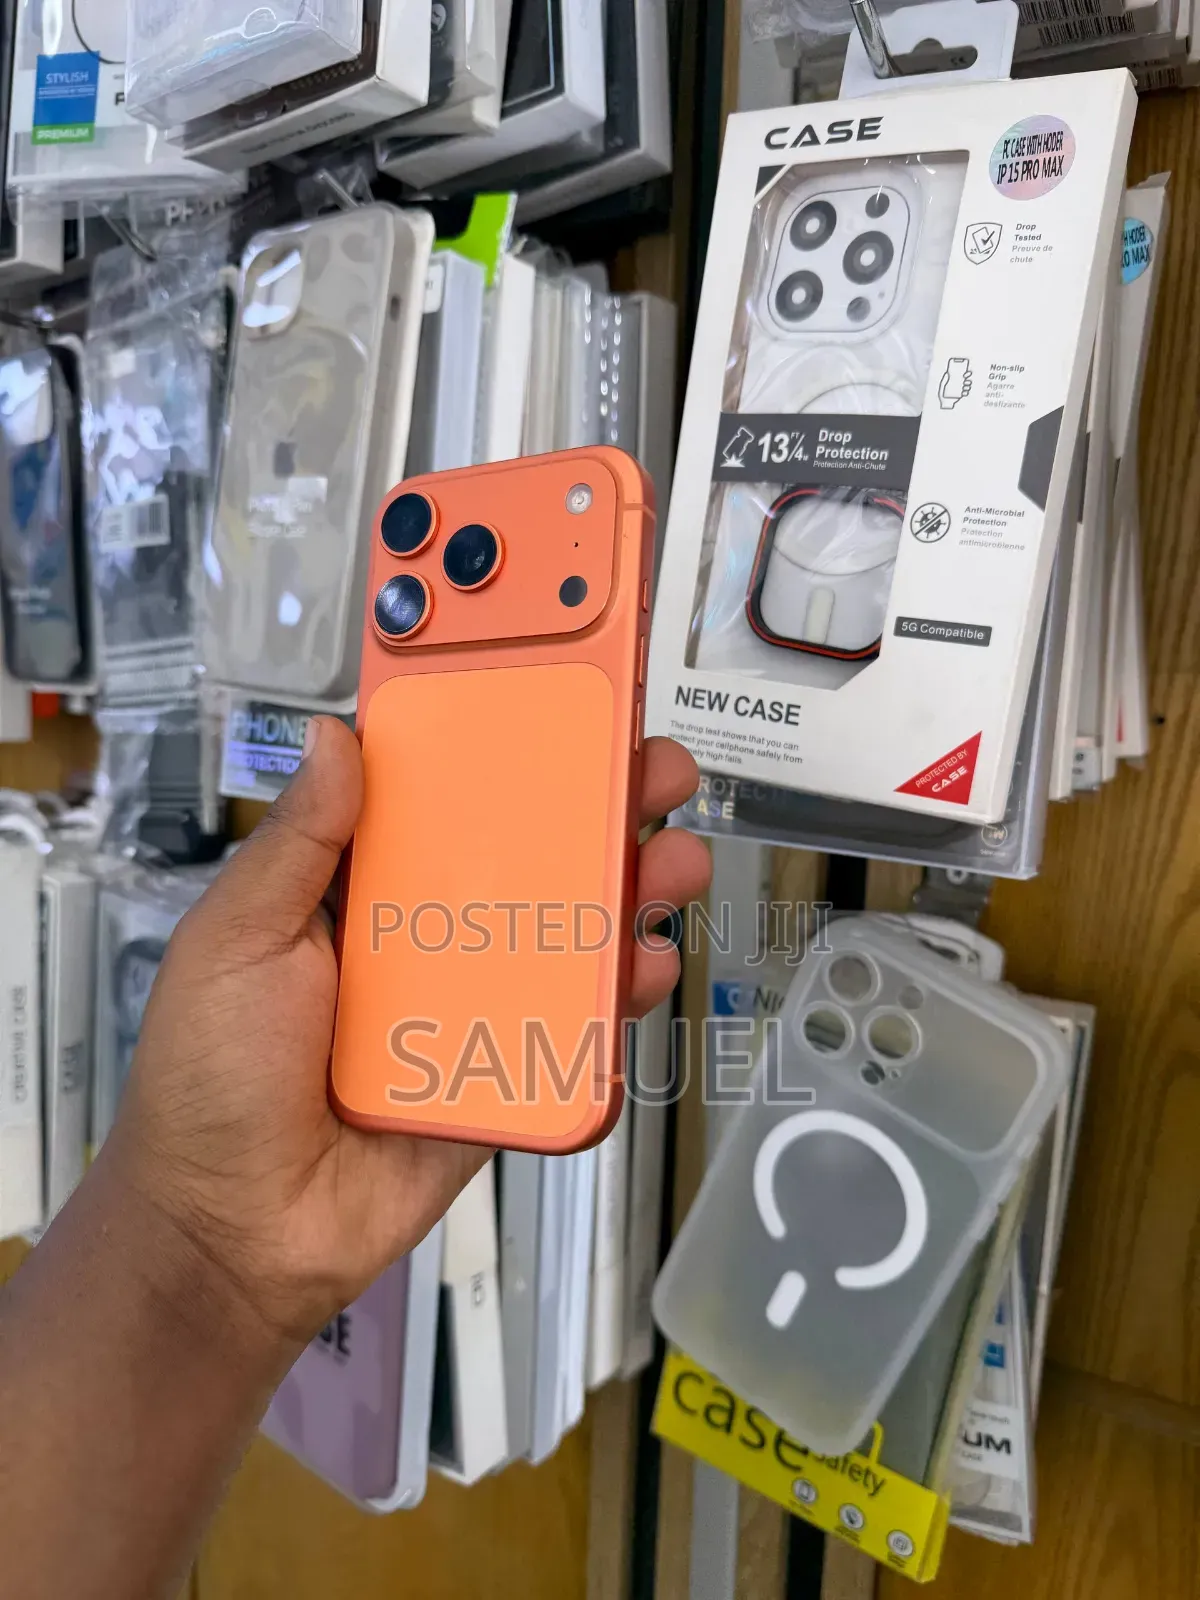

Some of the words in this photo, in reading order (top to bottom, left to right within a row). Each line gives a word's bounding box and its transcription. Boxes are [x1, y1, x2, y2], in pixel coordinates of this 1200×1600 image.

[46, 71, 89, 84] STYLISH
[37, 127, 89, 140] PREMIUM
[764, 116, 884, 150] CASE
[1002, 139, 1010, 159] PC
[1011, 136, 1026, 158] CASE
[1042, 131, 1064, 153] HODER
[997, 163, 1007, 184] IP
[1008, 161, 1019, 183] 15
[1021, 158, 1040, 181] PRO
[1041, 155, 1065, 177] MAX
[1016, 223, 1037, 231] Drop
[1132, 244, 1151, 265] MAX
[988, 372, 1007, 382] Grip
[990, 363, 1025, 374] Non-slip
[986, 381, 1015, 391] Agarre
[818, 429, 852, 445] Drop
[815, 445, 889, 461] Protection
[813, 460, 847, 469] Protection
[848, 462, 887, 471] Anti-Chute
[964, 506, 1025, 518] Anti-Microbial
[963, 516, 1007, 527] Protection
[961, 527, 1003, 538] Protection
[901, 621, 918, 632] 5G
[920, 623, 984, 640] Compatible
[675, 685, 730, 713] NEW
[733, 695, 802, 726] CASE
[670, 720, 685, 730] The
[685, 725, 704, 734] drop
[705, 727, 720, 736] test
[721, 730, 747, 741] shows
[748, 735, 765, 744] that
[765, 738, 782, 749] you
[783, 742, 799, 751] can
[696, 738, 715, 749] your
[715, 740, 755, 756] cellphone
[756, 749, 781, 761] safely
[783, 753, 803, 764] from
[706, 751, 724, 763] high
[915, 756, 958, 788] PROTECTED
[956, 749, 968, 760] BY
[931, 765, 968, 793] CASE
[672, 1369, 810, 1473] case
[963, 1429, 1011, 1455] UM
[815, 1451, 887, 1498] afety
